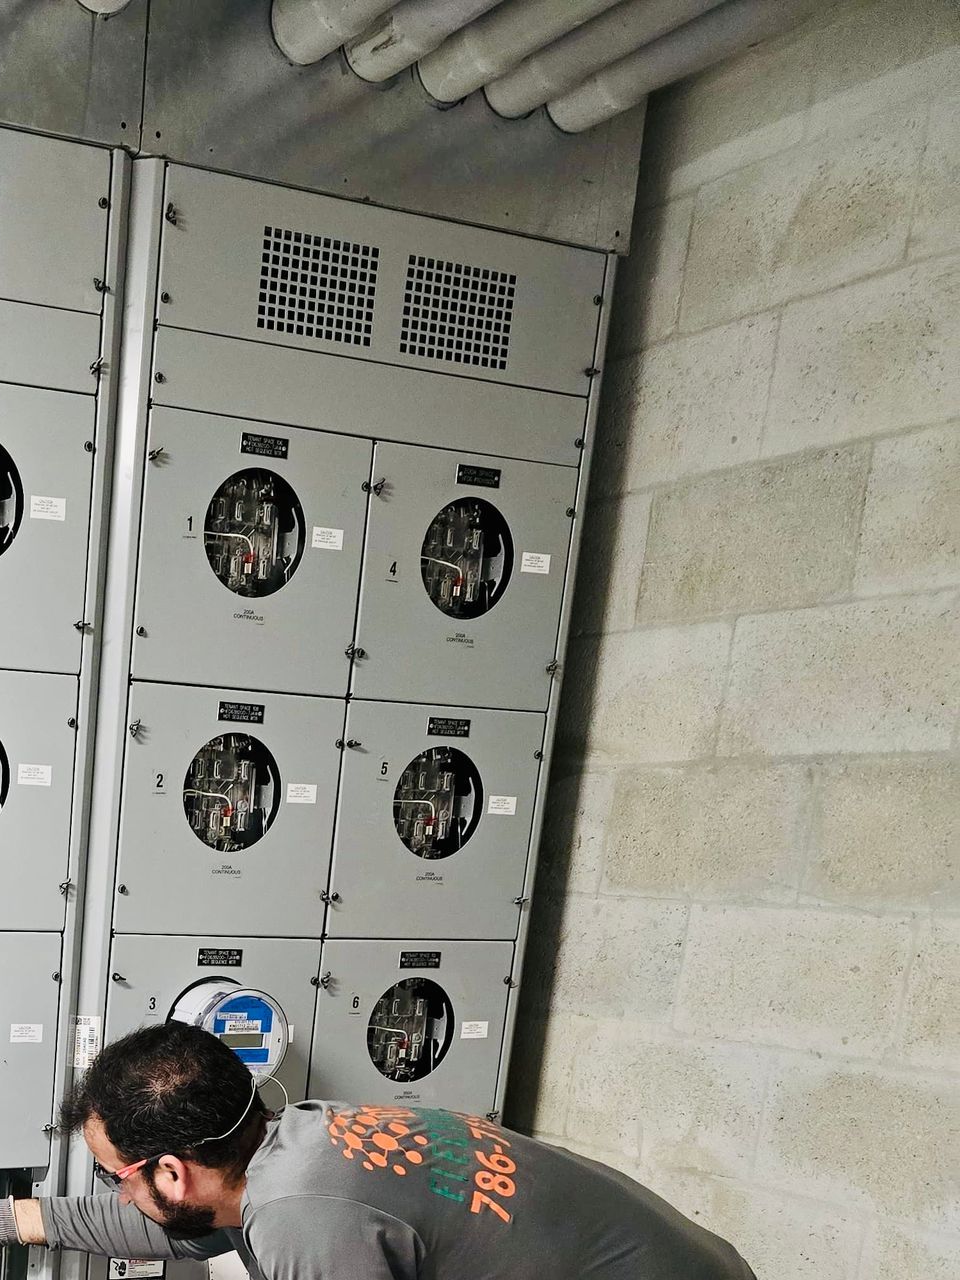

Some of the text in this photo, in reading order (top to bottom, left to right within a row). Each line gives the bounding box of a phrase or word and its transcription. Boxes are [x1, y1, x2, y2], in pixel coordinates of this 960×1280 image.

[187, 515, 194, 532] 1
[389, 561, 397, 577] 4
[233, 613, 264, 621] CONTINUOUS
[380, 761, 389, 776] 5
[156, 773, 164, 788] 2
[148, 996, 156, 1010] 3
[351, 995, 360, 1010] 6
